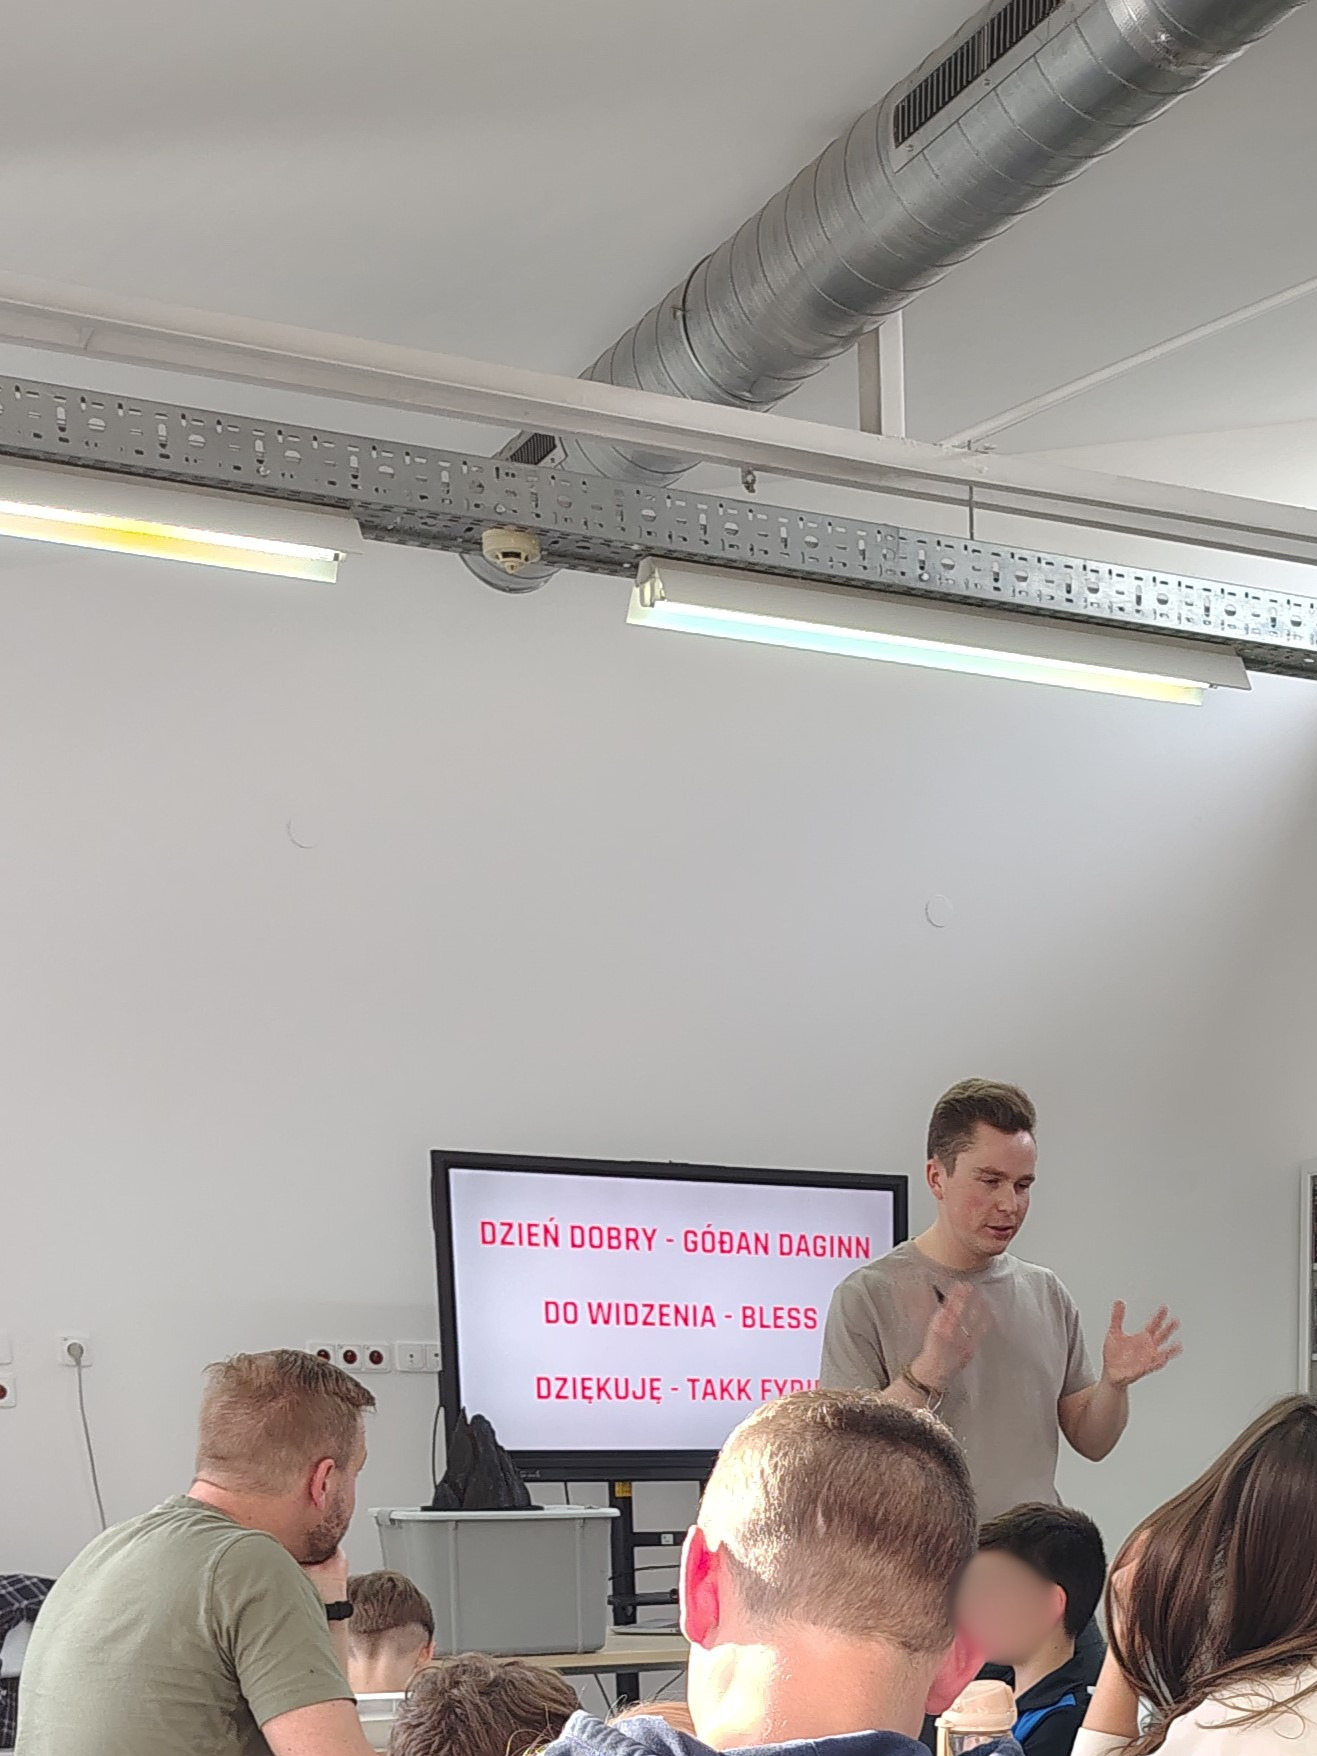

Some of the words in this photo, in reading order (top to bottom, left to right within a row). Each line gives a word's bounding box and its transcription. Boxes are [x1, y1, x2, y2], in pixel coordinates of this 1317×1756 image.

[479, 1216, 560, 1249] DZIEŃ
[569, 1224, 658, 1252] DOBRY
[682, 1223, 770, 1257] GÓÐAN
[778, 1232, 871, 1260] DAGINN
[543, 1300, 579, 1325] DO
[586, 1301, 717, 1328] WIDZENIA
[741, 1305, 819, 1331] BLESS
[535, 1375, 663, 1405] DZIĘKUJĘ
[686, 1377, 753, 1402] TAKK
